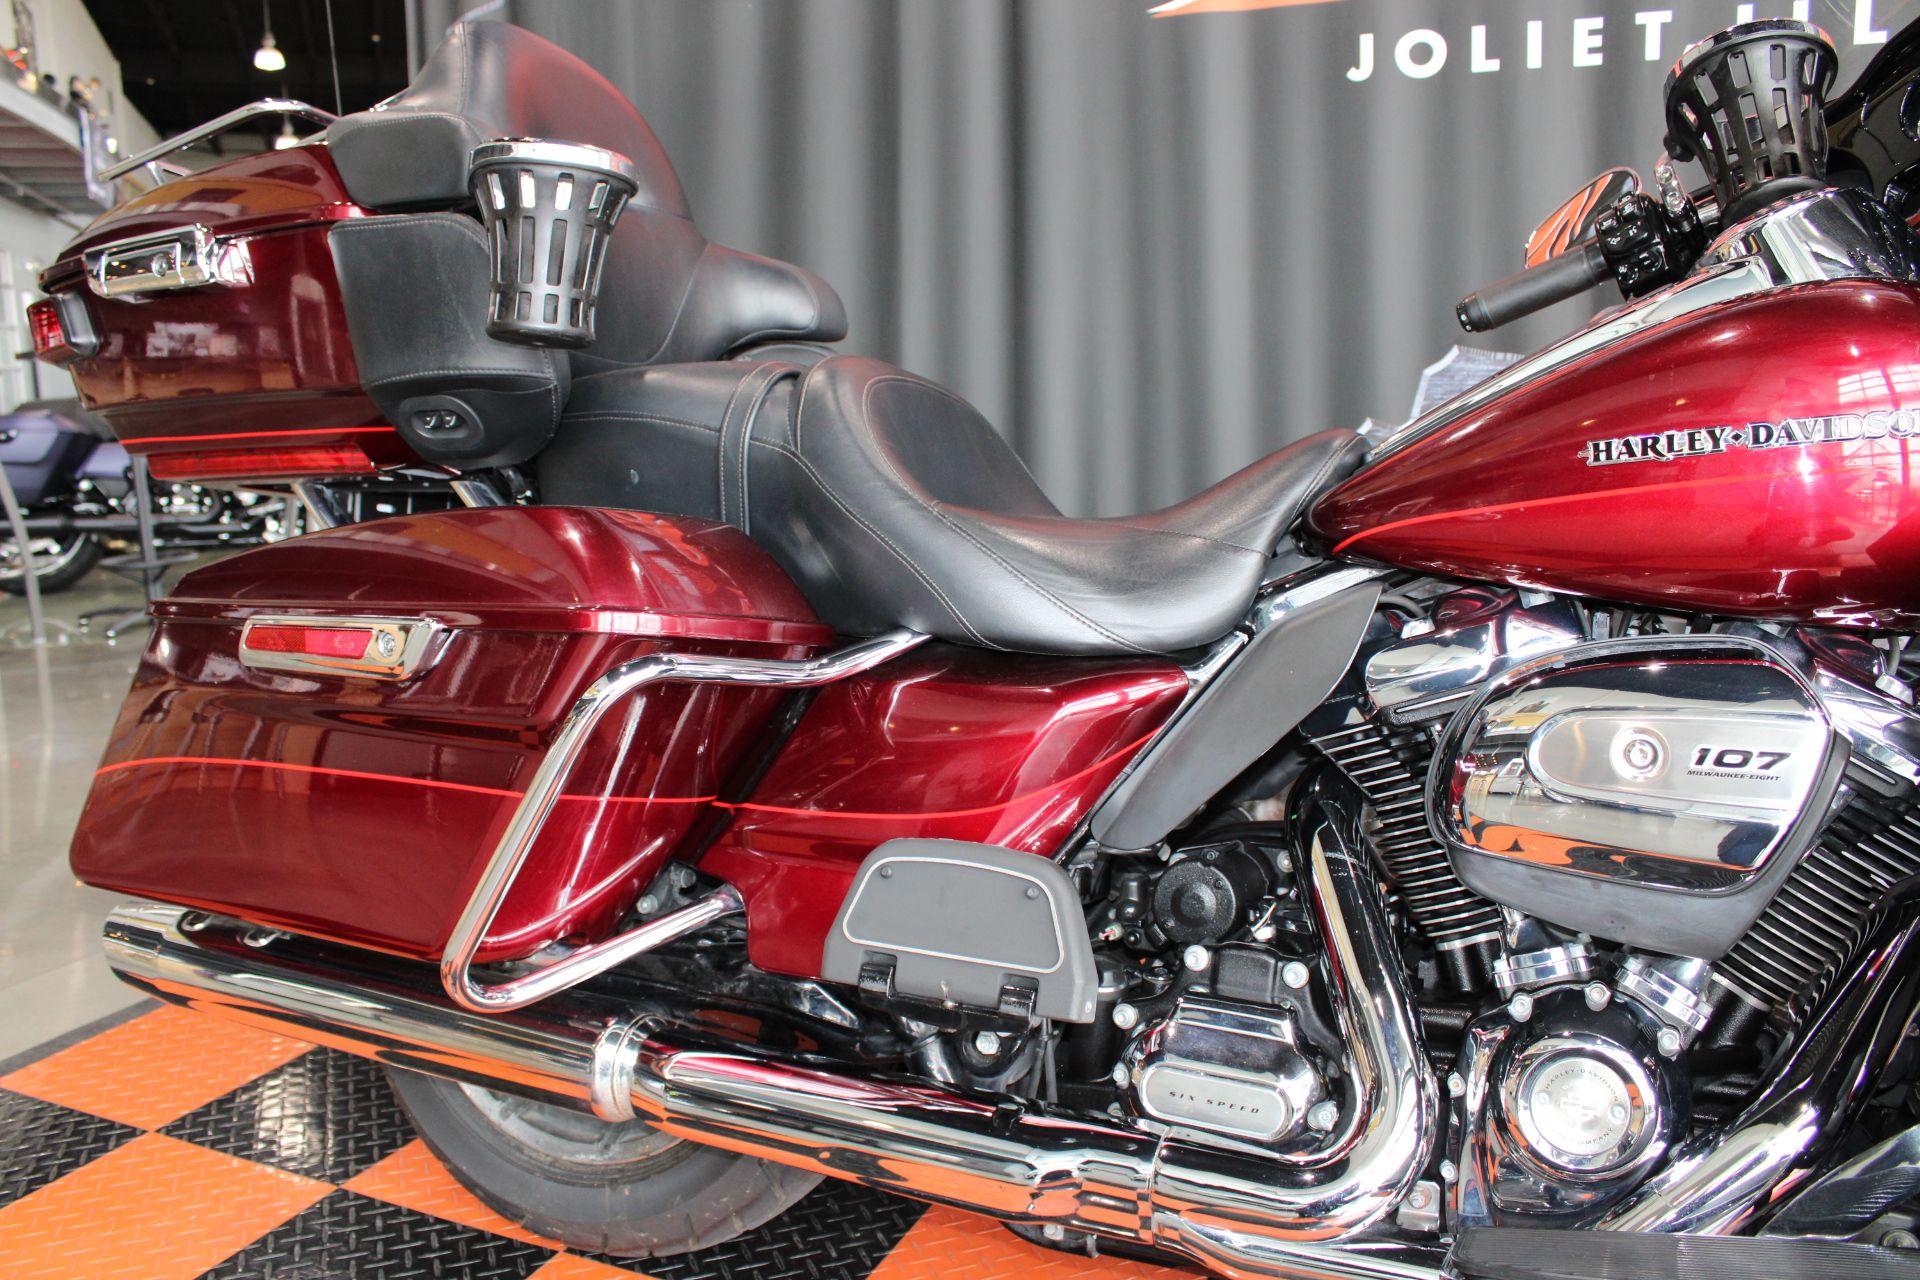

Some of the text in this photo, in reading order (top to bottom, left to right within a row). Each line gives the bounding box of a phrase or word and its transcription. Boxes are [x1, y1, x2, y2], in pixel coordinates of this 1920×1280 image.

[1747, 409, 1920, 448] DAVIDSO
[1694, 747, 1792, 770] 107
[1686, 769, 1782, 782] MILWAUKEE-EIGHT
[1168, 1090, 1260, 1114] SIX SPEED
